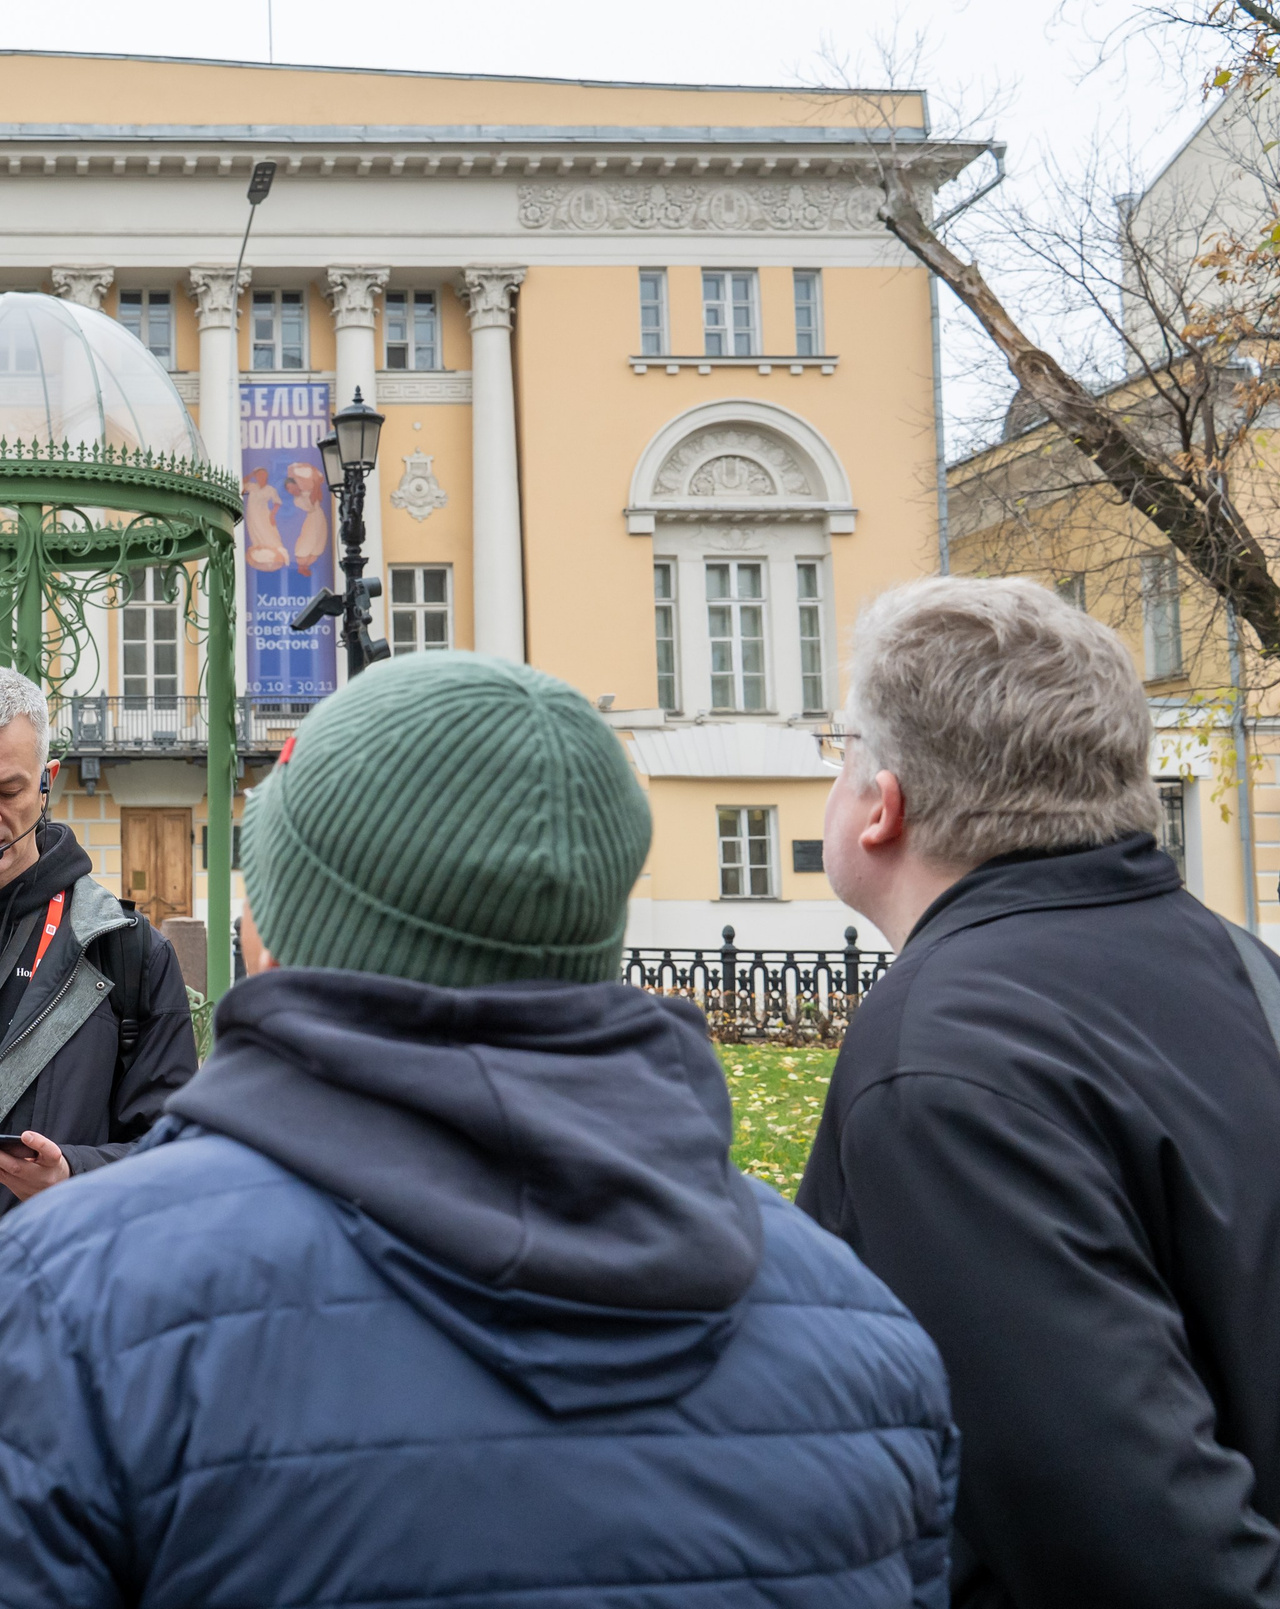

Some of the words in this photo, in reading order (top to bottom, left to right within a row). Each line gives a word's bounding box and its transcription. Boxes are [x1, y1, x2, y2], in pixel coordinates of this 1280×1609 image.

[240, 387, 326, 417] БЕЛОЕ
[255, 637, 319, 651] Востока
[247, 682, 284, 693] 10.10
[296, 681, 334, 696] 30.11
